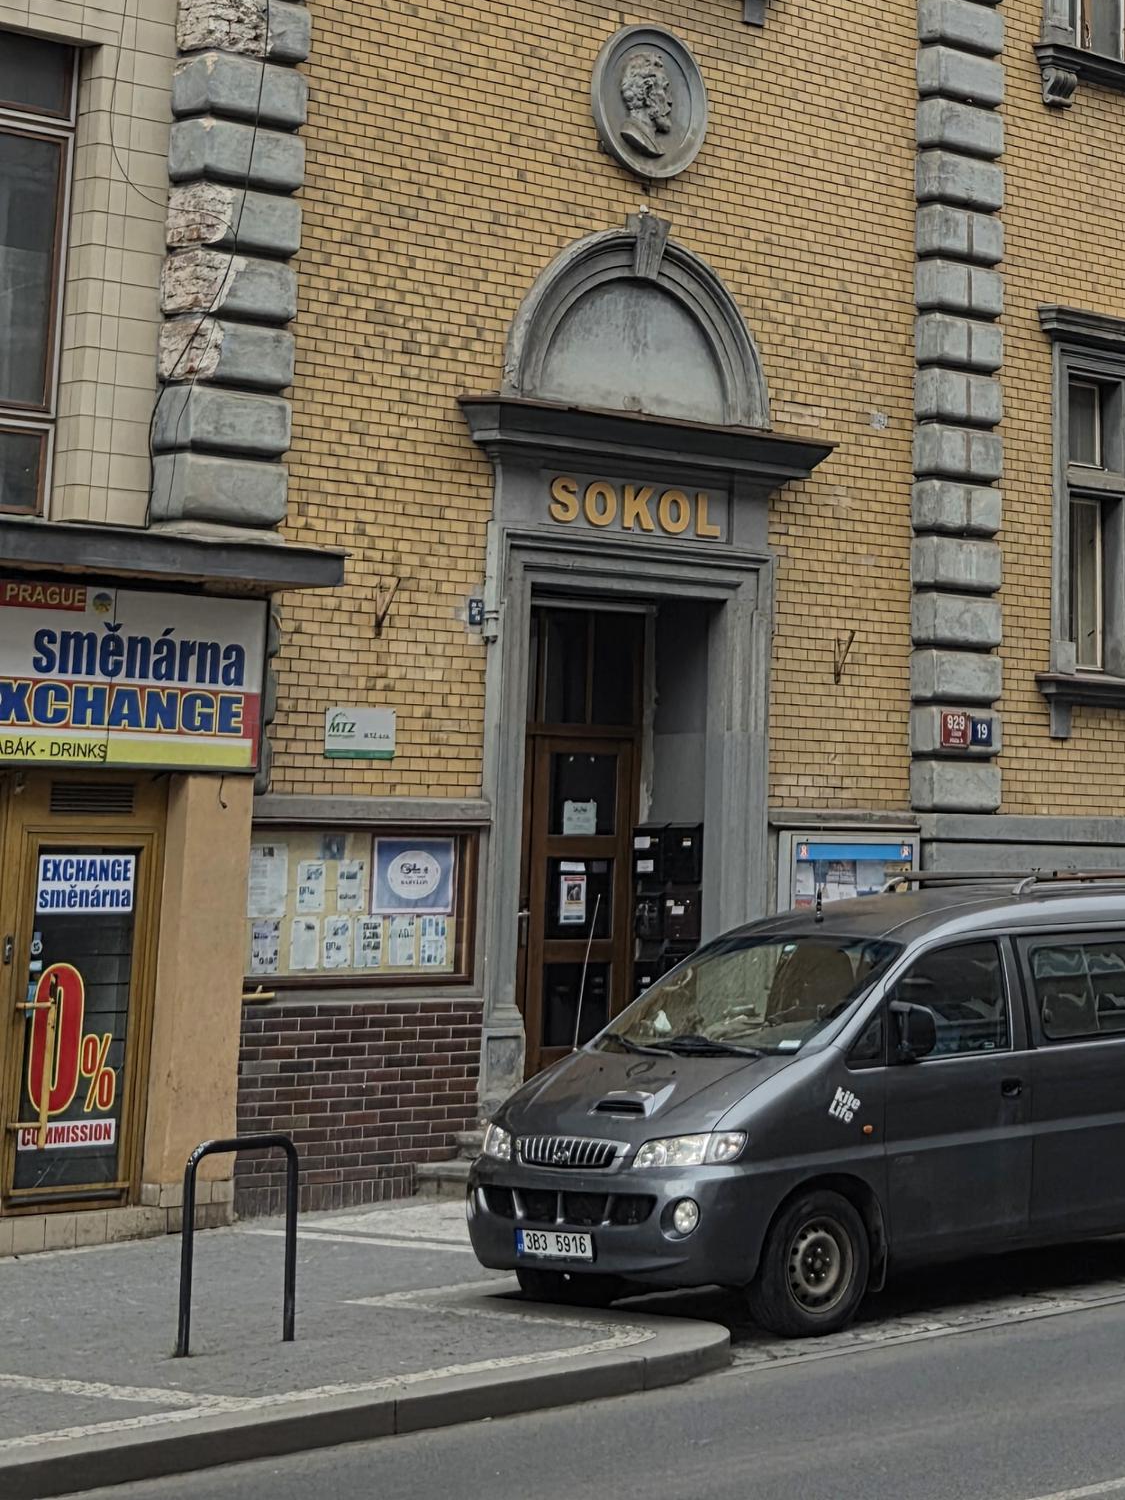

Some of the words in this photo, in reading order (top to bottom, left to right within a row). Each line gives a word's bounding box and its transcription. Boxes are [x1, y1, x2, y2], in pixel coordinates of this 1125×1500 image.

[549, 476, 721, 538] SOKOL
[6, 583, 86, 607] PRAGUE
[32, 621, 246, 687] směnárna
[328, 721, 356, 733] MTZ
[976, 723, 988, 739] 19
[49, 741, 107, 760] DRINKS
[41, 859, 132, 882] EXCHANGE
[38, 884, 131, 909] směnárna
[834, 1086, 861, 1111] kite
[829, 1099, 854, 1123] Life
[525, 1232, 548, 1251] 3B3
[555, 1234, 587, 1254] 5916
